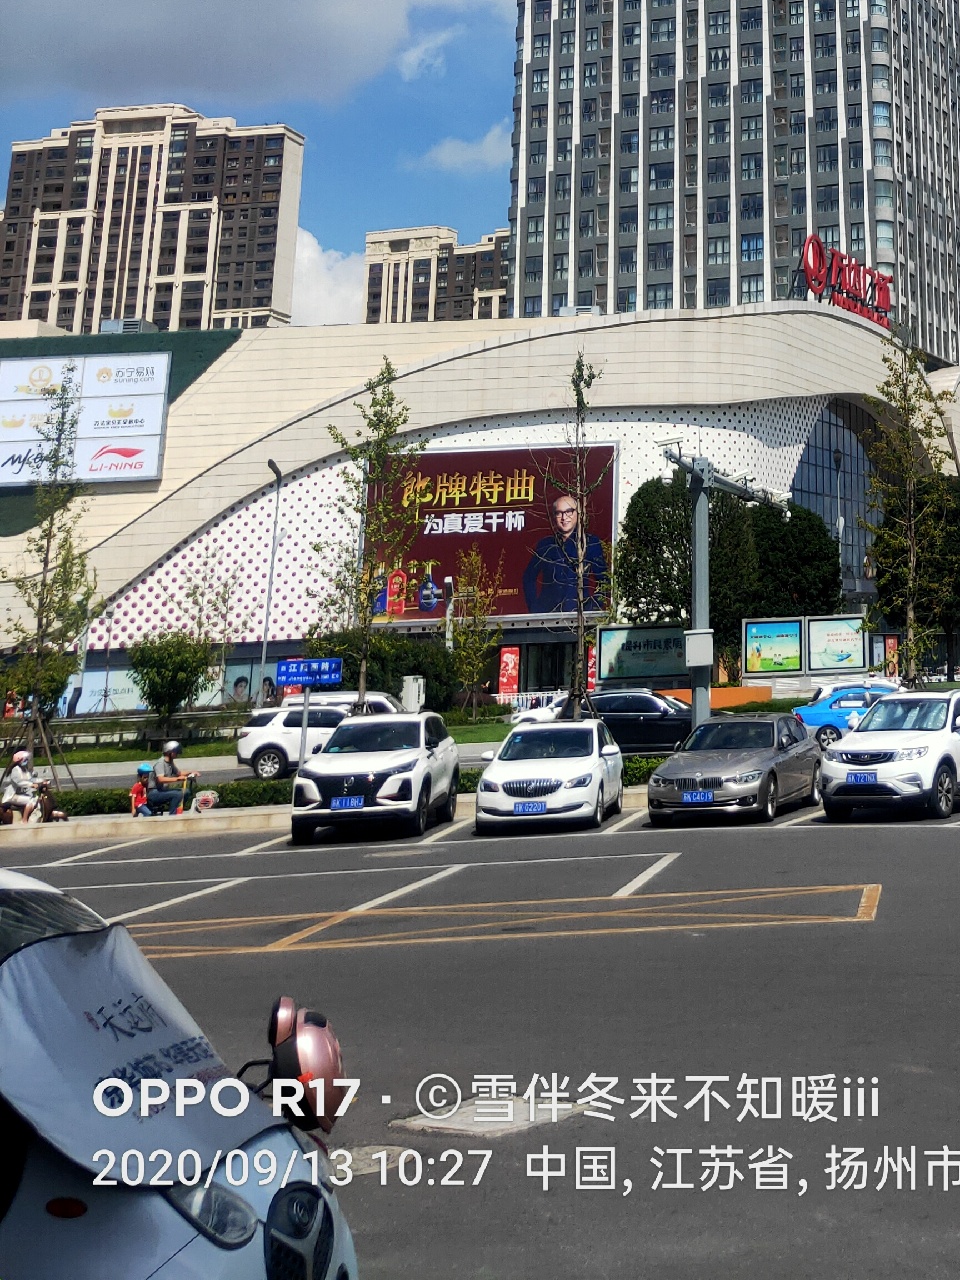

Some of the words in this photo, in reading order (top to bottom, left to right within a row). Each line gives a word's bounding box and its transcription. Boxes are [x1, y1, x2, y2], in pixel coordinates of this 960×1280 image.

[115, 366, 155, 379] 苏宁易购
[89, 461, 144, 472] LI-NING
[423, 510, 526, 535] 为真爱干杯
